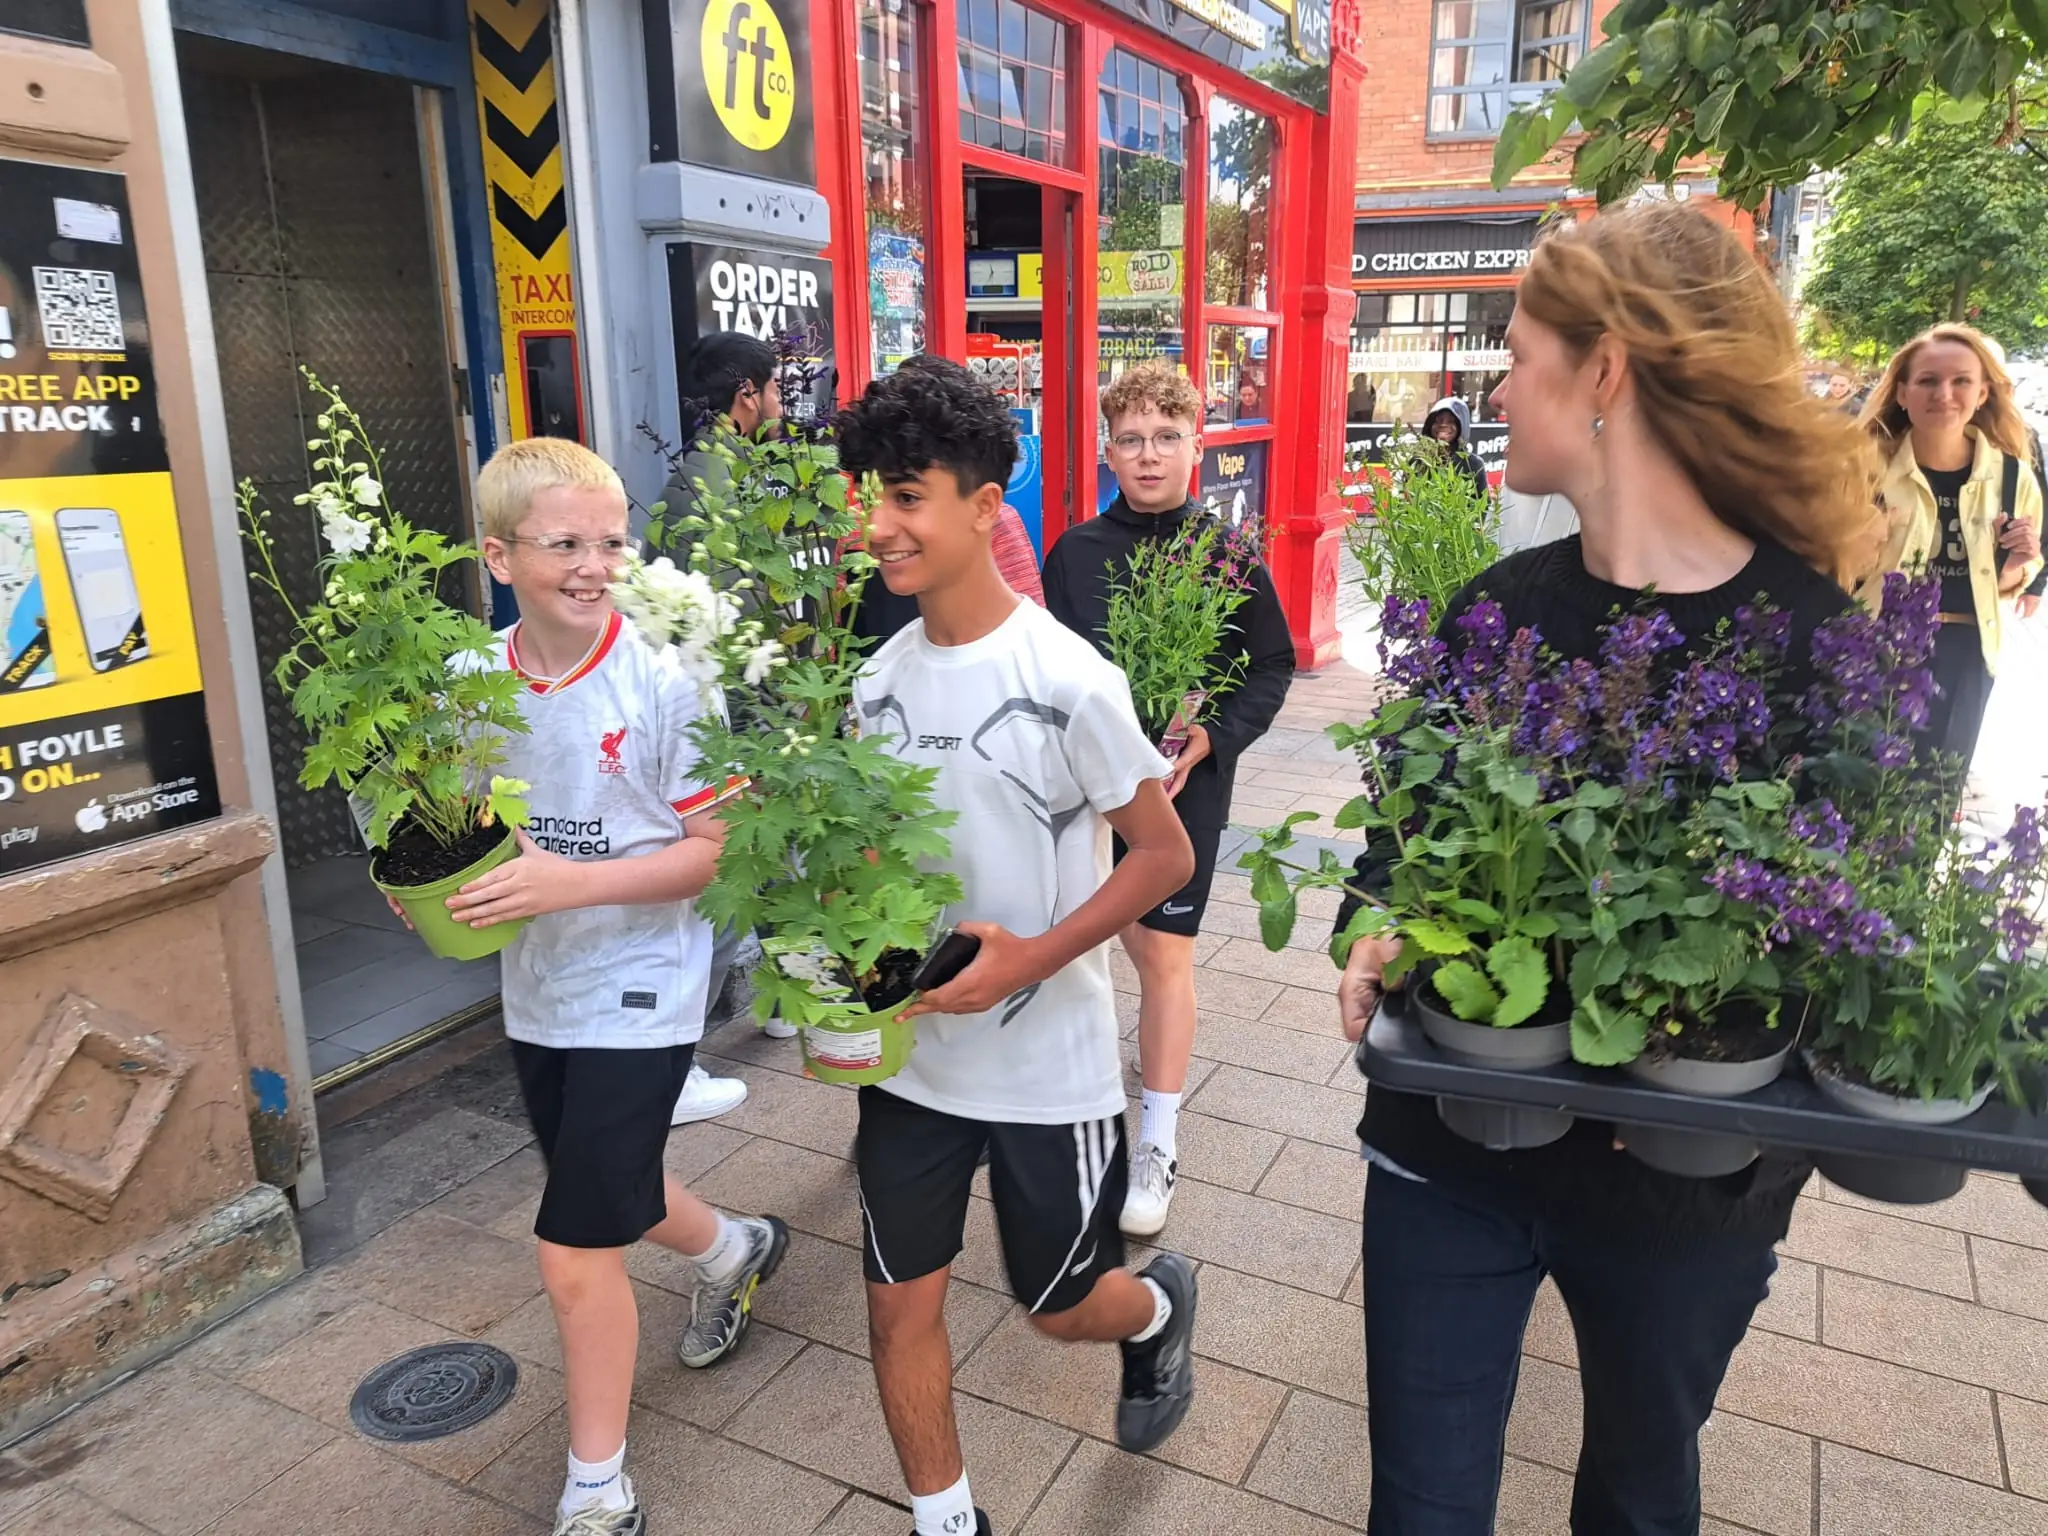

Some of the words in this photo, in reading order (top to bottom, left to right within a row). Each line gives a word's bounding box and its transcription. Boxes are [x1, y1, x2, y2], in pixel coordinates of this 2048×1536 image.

[1297, 1, 1328, 52] VAPE
[1371, 250, 1470, 272] CHICKEN
[1474, 248, 1534, 269] EXPR
[510, 273, 573, 304] TAXI
[709, 259, 819, 309] ORDER
[511, 308, 576, 325] INTERCOM
[711, 299, 787, 342] TAXI
[72, 374, 142, 401] APP
[1217, 452, 1245, 480] Vape
[17, 723, 125, 768] FOYLE
[917, 734, 963, 751] SPORT
[21, 761, 102, 793] ON...
[107, 782, 163, 803] Download
[177, 775, 196, 788] the
[112, 800, 151, 824] App
[152, 788, 199, 812] Store
[0, 825, 39, 851] play
